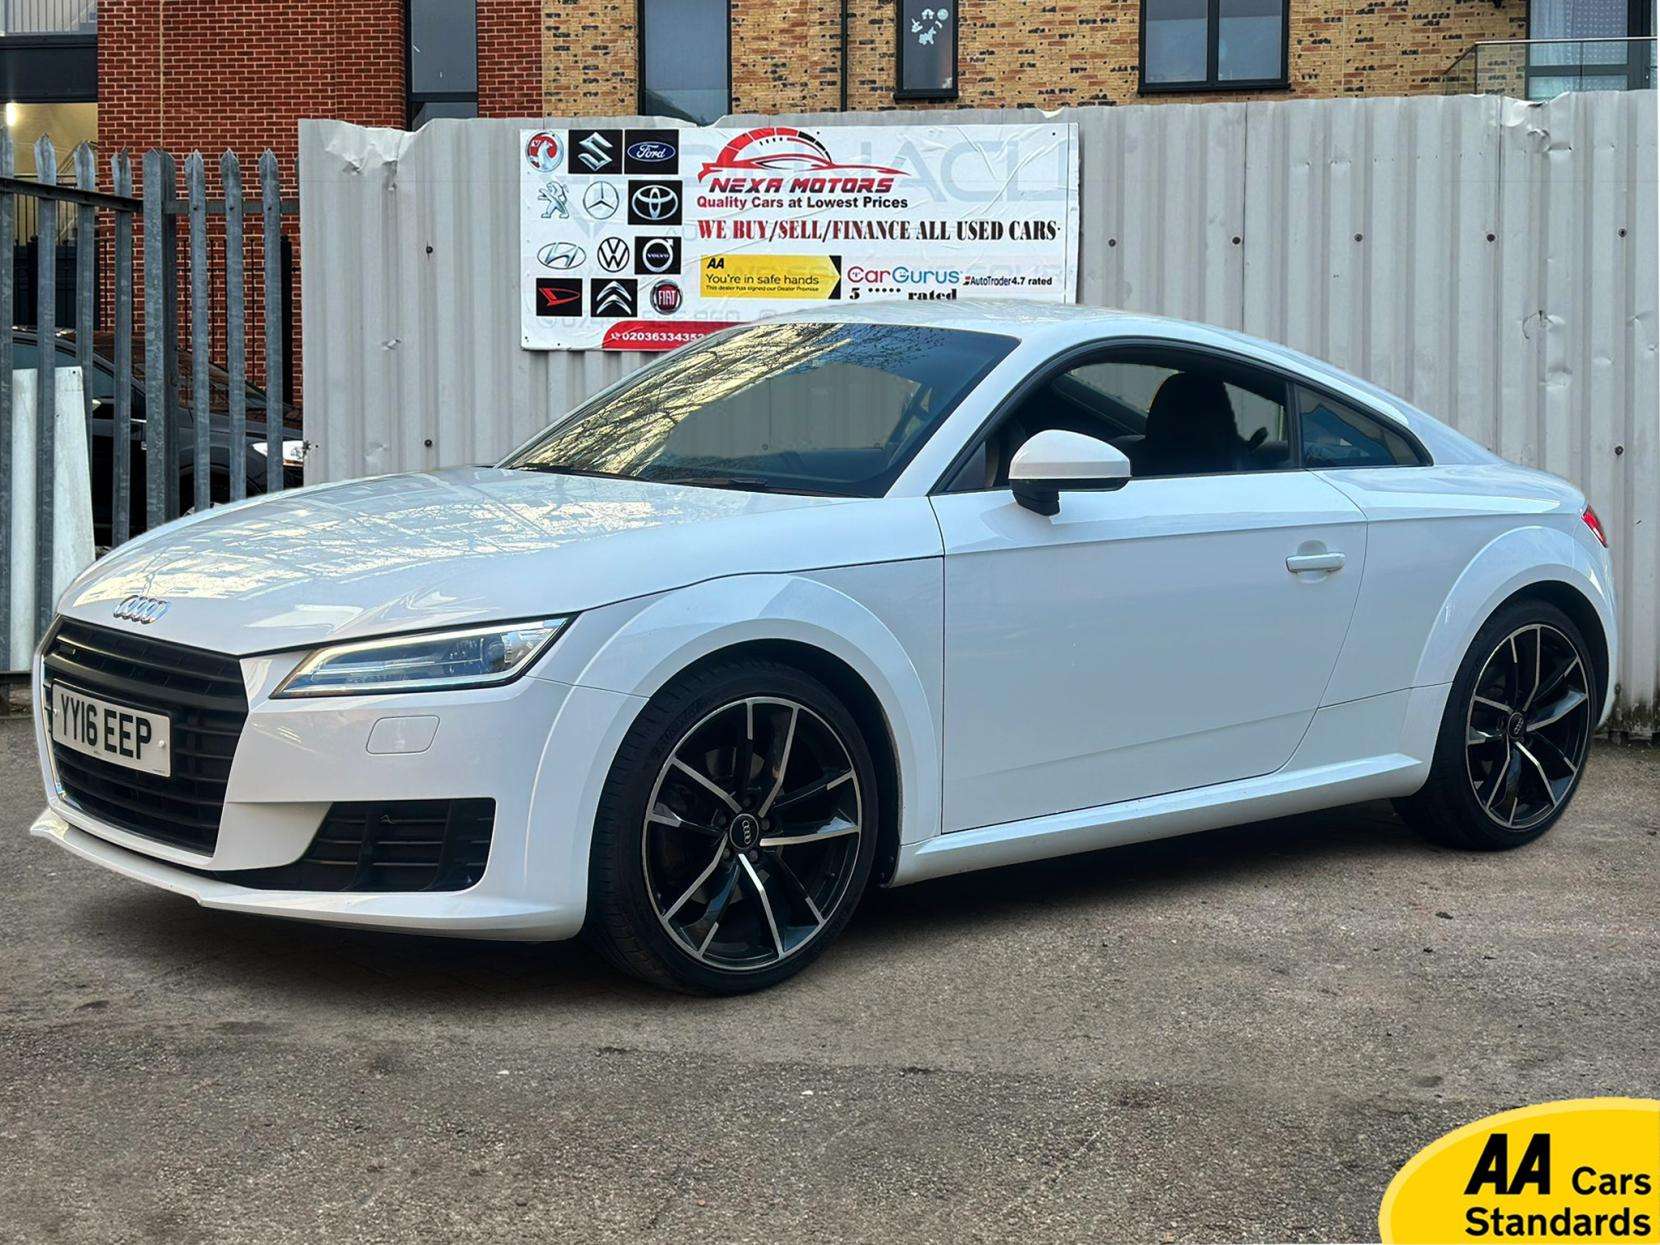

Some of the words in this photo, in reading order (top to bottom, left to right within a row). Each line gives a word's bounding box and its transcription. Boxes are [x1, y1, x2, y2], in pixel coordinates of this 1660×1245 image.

[709, 178, 783, 193] NEXA
[789, 178, 894, 193] MOTORS
[697, 196, 746, 210] Quality
[752, 196, 784, 208] Cars
[788, 197, 803, 208] at
[806, 196, 859, 208] Lowest
[863, 195, 908, 208] Prices
[697, 220, 726, 240] WE
[916, 220, 950, 240] ALL
[957, 220, 1004, 240] USED
[1008, 220, 1057, 240] CARS
[706, 258, 725, 269] AA
[706, 274, 741, 284] You're
[744, 274, 754, 284] in
[757, 274, 781, 285] safe
[784, 275, 820, 285] hands
[847, 266, 960, 284] CarGurus
[1028, 276, 1053, 286] rated
[849, 288, 861, 301] 5
[908, 289, 957, 301] rated
[61, 694, 98, 747] YY16
[104, 708, 152, 760] EEP
